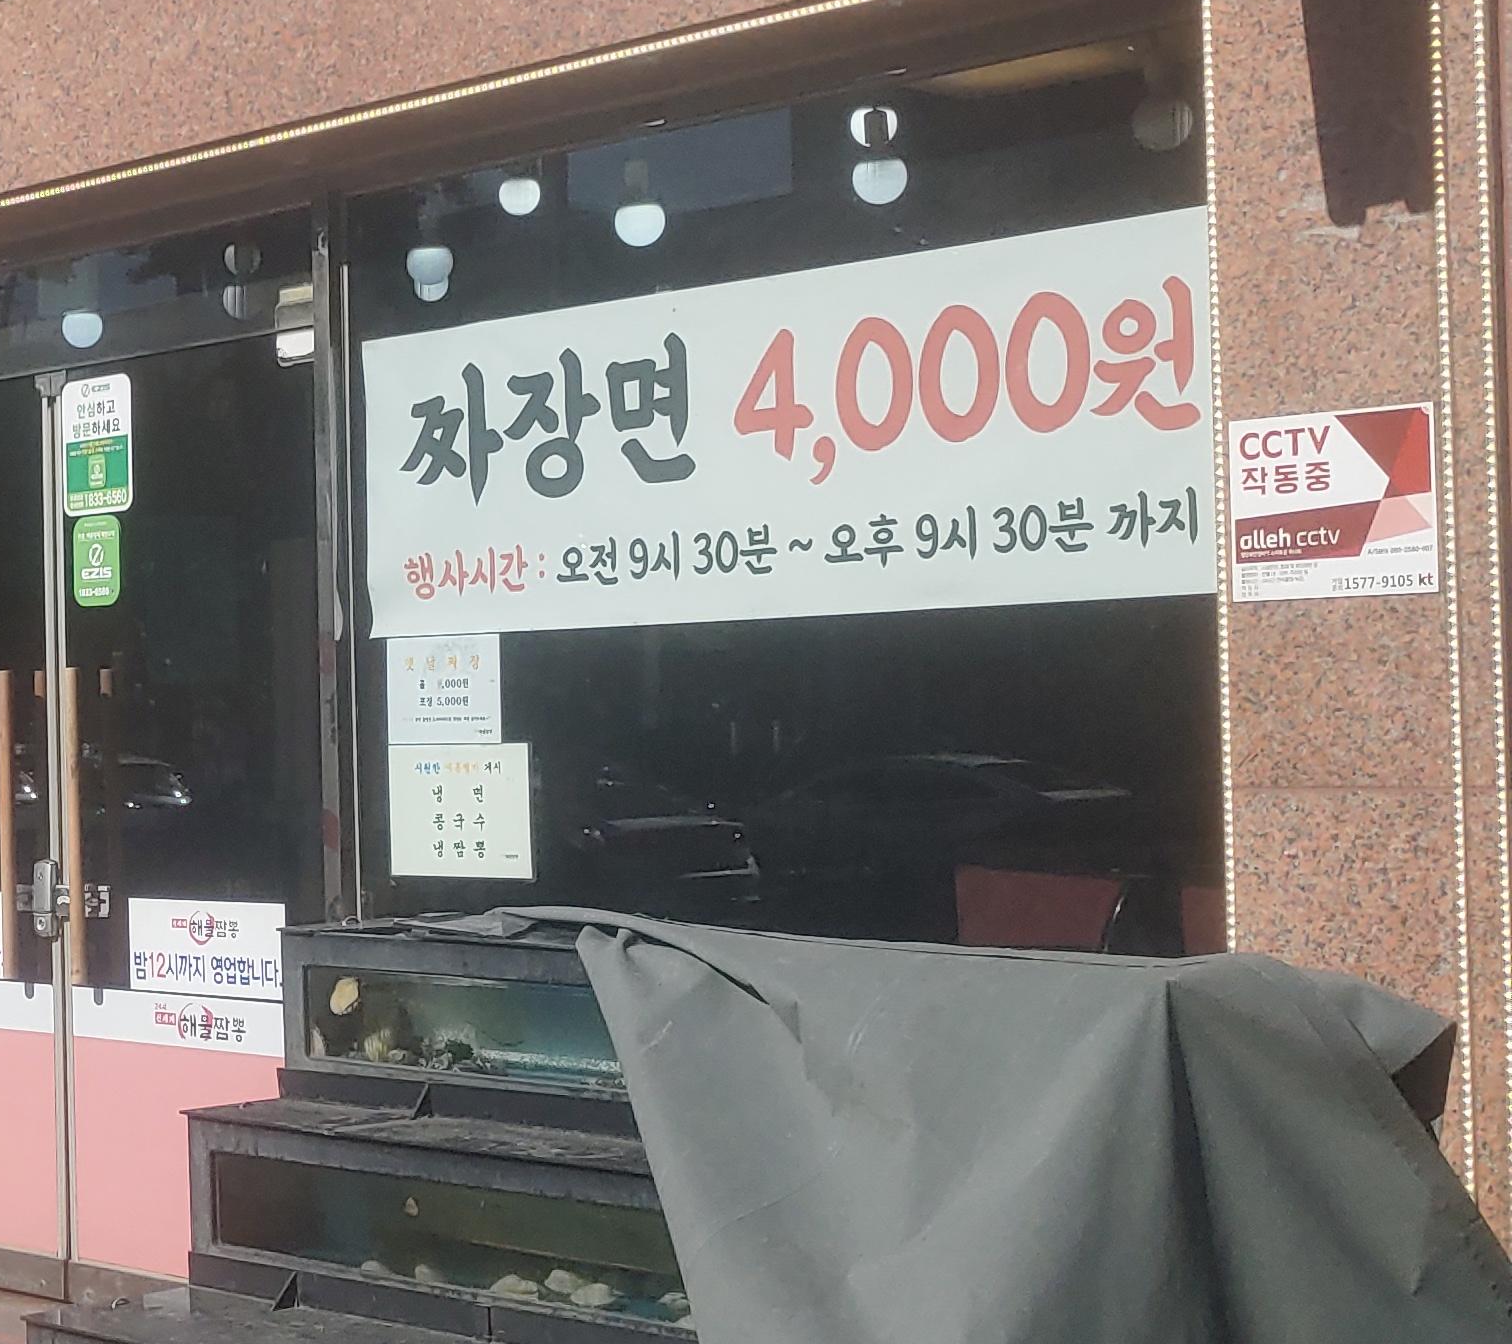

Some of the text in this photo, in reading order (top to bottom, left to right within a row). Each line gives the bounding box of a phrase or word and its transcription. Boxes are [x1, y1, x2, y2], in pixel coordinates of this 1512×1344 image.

[400, 275, 1202, 506] 짜장면 4,000원
[76, 399, 116, 420] 안심하고
[72, 418, 121, 438] 방문하세요
[1239, 425, 1331, 460] CCTV
[1241, 461, 1331, 495] 작동중
[556, 536, 619, 586] 오전
[628, 530, 680, 581] 9시
[692, 523, 778, 576] 30분
[825, 515, 904, 566] 오후
[915, 505, 977, 559] 9시
[992, 495, 1094, 552] 30분
[1108, 486, 1199, 546] 까지
[1296, 526, 1341, 548] cctv
[81, 566, 113, 580] EZIS
[1343, 572, 1435, 591] 1577-9105 kt
[134, 951, 205, 983] 밤12시까지
[180, 1014, 246, 1043] 해물짬뽕
